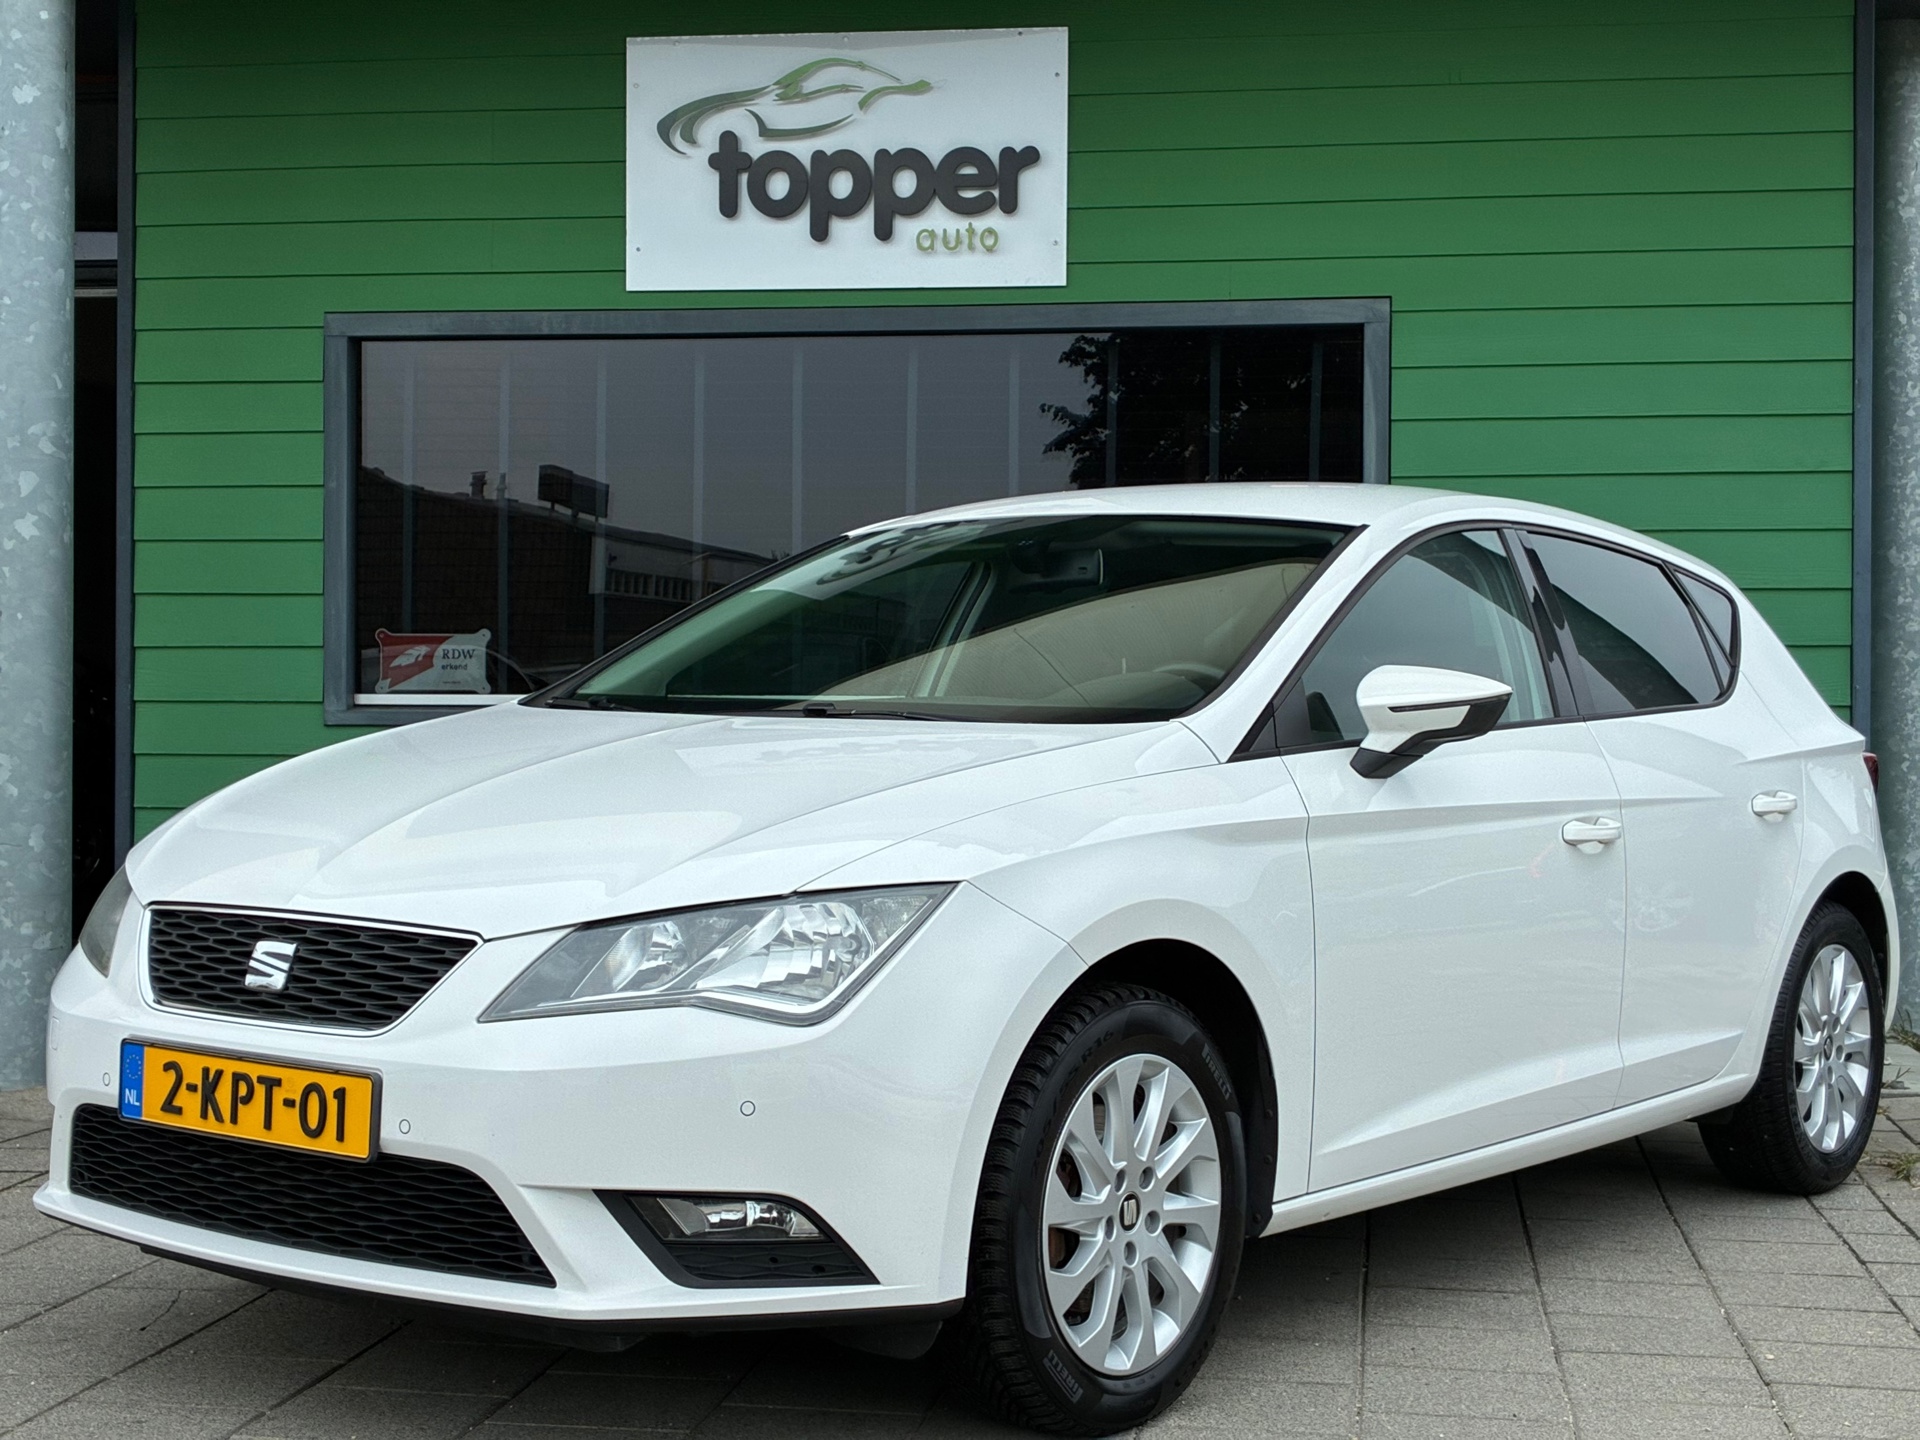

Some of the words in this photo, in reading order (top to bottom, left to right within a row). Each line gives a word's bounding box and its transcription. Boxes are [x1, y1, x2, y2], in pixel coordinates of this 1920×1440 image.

[708, 130, 1040, 242] topper
[916, 222, 999, 252] auto
[441, 648, 476, 660] RDW
[441, 663, 468, 671] erkend
[1199, 1042, 1232, 1101] PIRELLI
[125, 1088, 140, 1107] NL
[160, 1060, 347, 1143] 2-KPT-01
[1042, 1349, 1084, 1404] PIRELLI
